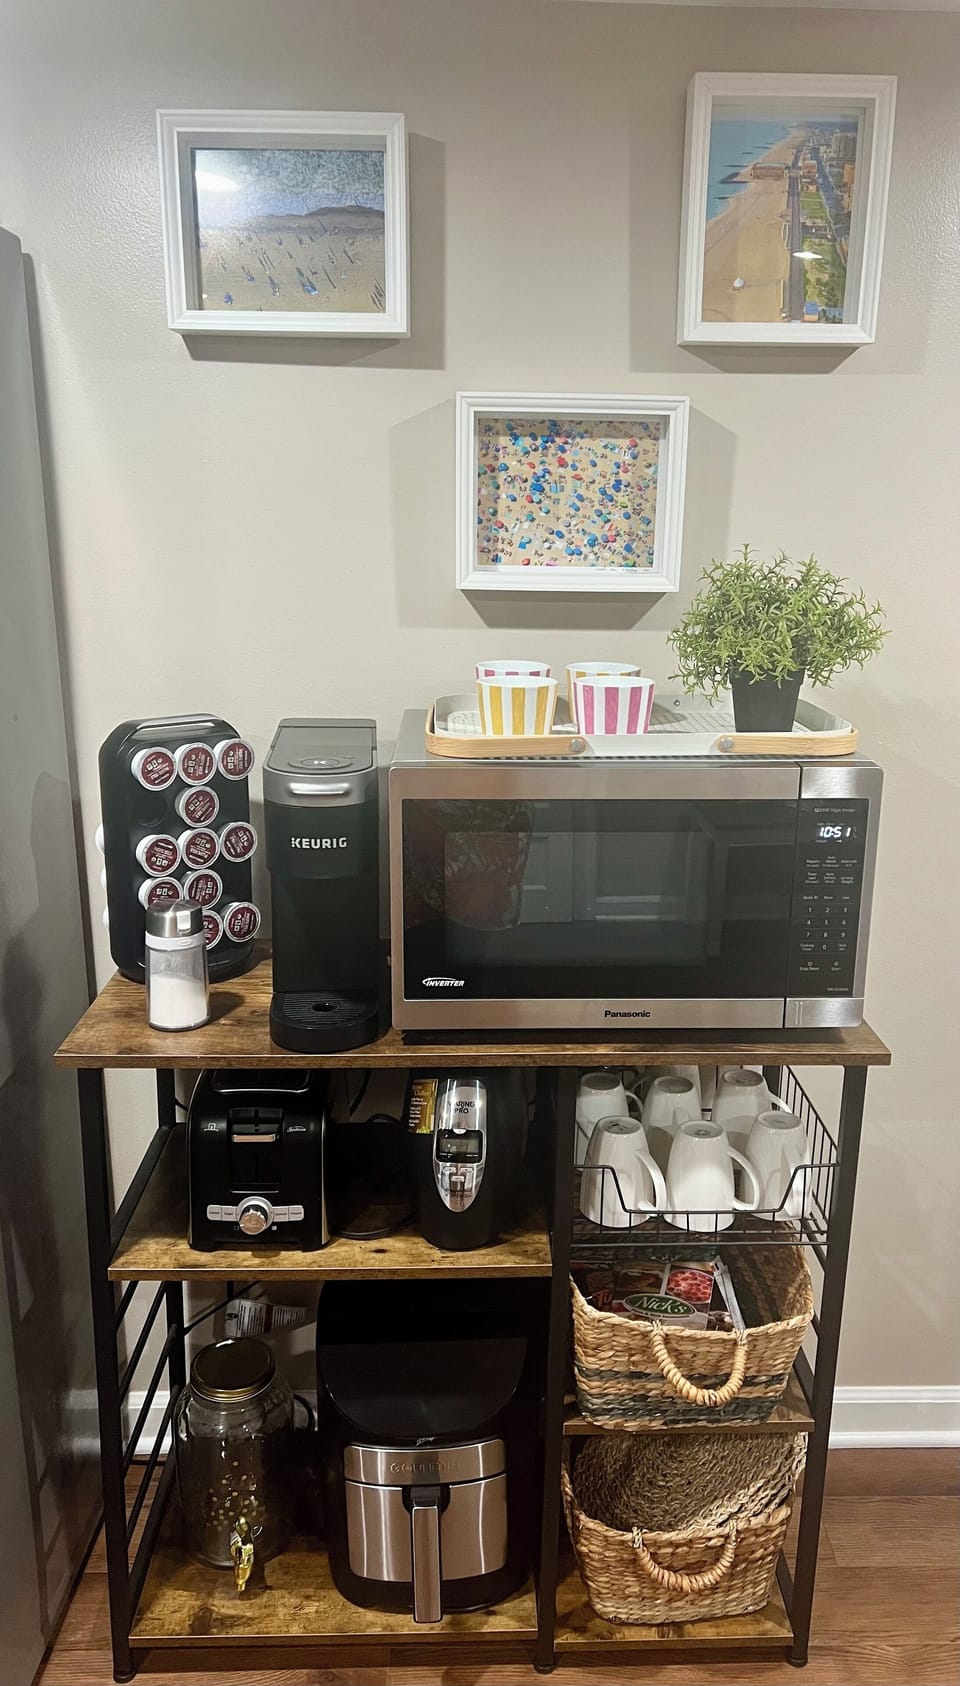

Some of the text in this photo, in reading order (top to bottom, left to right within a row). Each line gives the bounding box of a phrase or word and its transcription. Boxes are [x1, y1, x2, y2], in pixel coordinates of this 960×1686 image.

[819, 826, 852, 838] 10:51
[291, 837, 348, 849] KEURIG
[424, 979, 465, 987] INVERTER
[604, 1010, 651, 1018] Panasonic
[634, 1297, 688, 1313] Nick's
